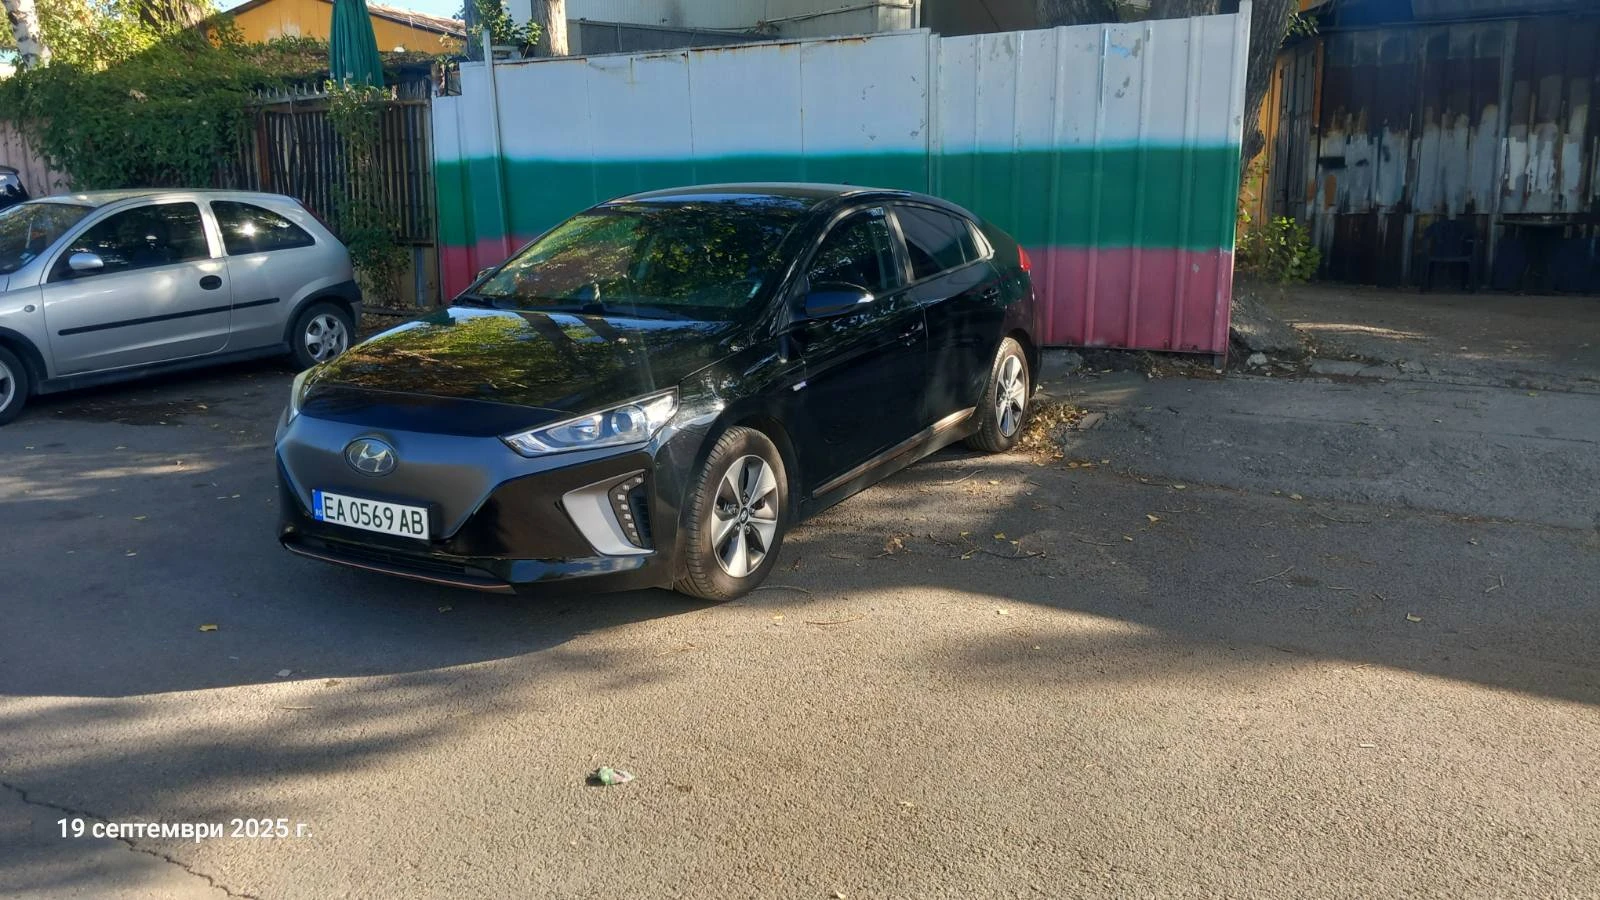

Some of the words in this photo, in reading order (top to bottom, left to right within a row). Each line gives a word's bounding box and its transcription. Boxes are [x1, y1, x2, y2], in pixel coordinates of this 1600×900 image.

[324, 496, 346, 522] EA
[350, 502, 394, 530] 0569
[400, 509, 424, 534] AB
